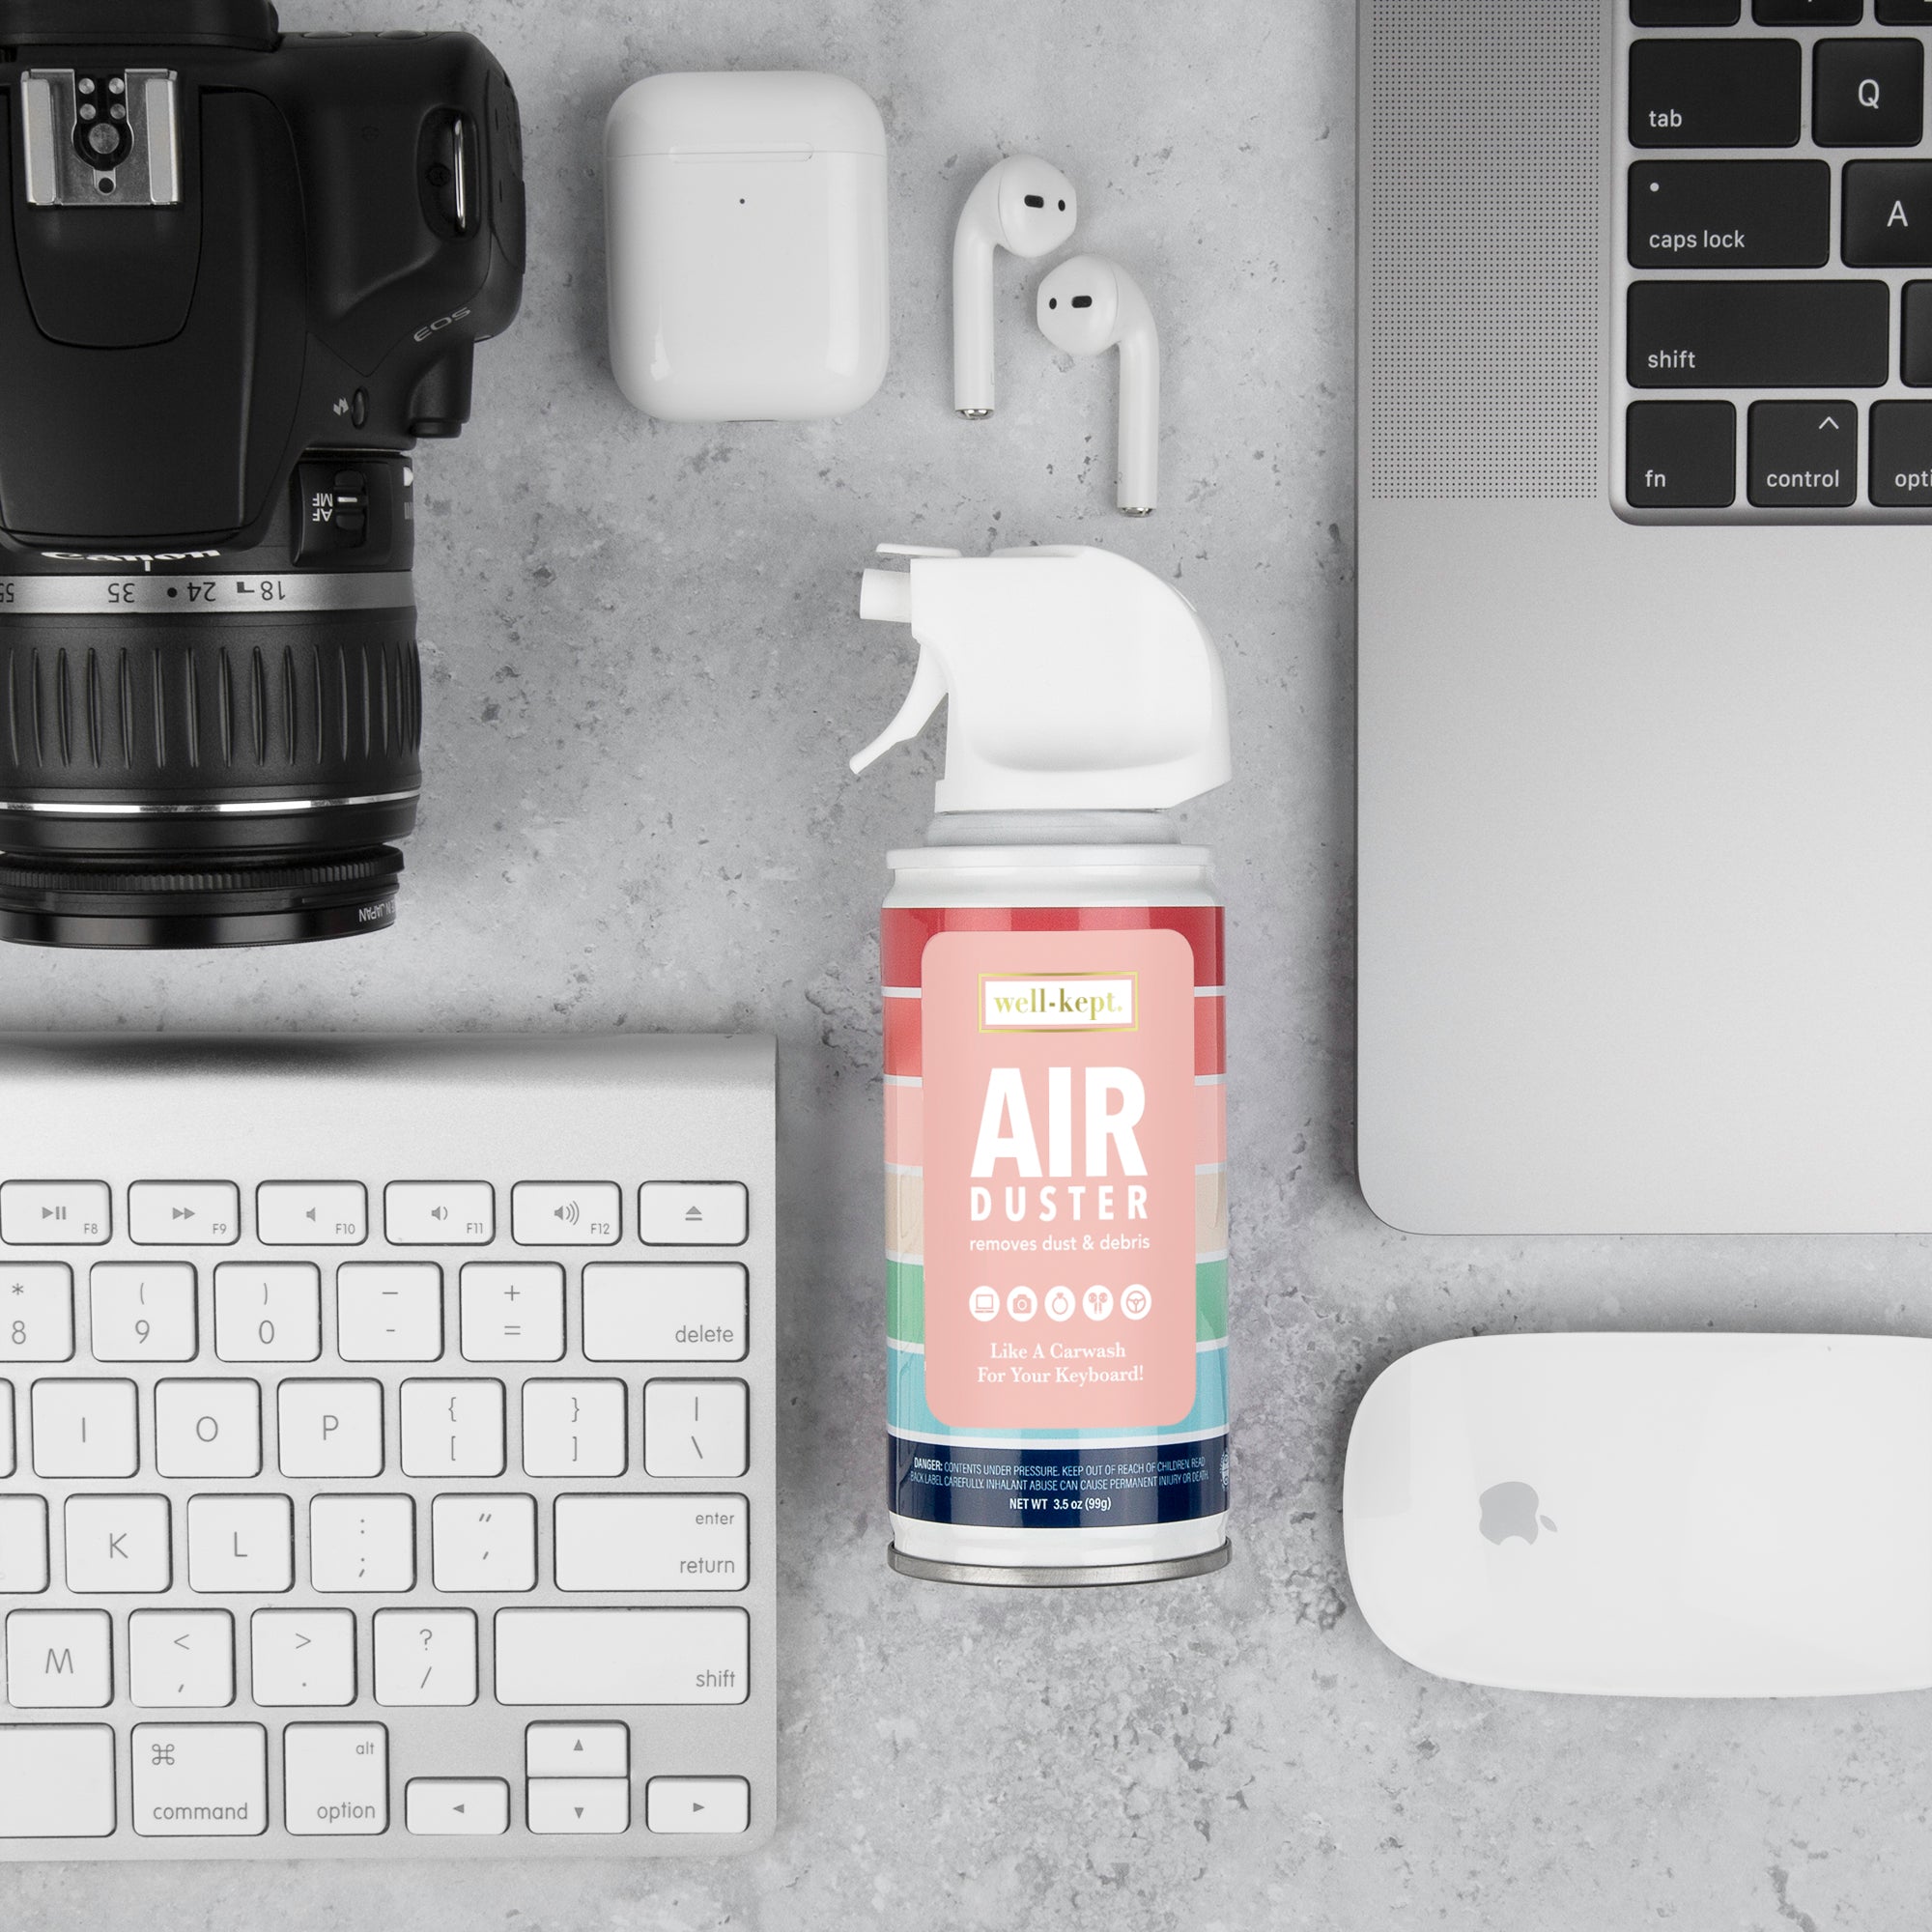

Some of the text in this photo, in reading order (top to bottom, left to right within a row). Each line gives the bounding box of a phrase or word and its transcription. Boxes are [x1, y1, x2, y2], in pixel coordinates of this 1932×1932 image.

[1859, 79, 1880, 108] Q
[1649, 109, 1682, 128] tab
[1887, 201, 1908, 227] A
[1649, 229, 1746, 252] caps lock
[414, 307, 470, 342] EOS
[1648, 351, 1695, 368] shift
[1645, 470, 1665, 487] fn
[1767, 469, 1839, 488] control
[312, 493, 333, 507] MF
[312, 508, 333, 522] AF
[41, 550, 221, 561] Canon
[107, 582, 135, 603] 35
[186, 582, 215, 602] 24
[261, 581, 287, 600] 18
[994, 987, 1122, 1021] well-kept.
[970, 1066, 1149, 1178] AIR
[970, 1185, 1149, 1222] DUSTER
[83, 1224, 99, 1235] F8
[213, 1224, 227, 1235] F9
[335, 1224, 355, 1235] F10
[467, 1223, 483, 1234] F11
[590, 1224, 611, 1235] F12
[970, 1234, 1151, 1251] removes dust & debris
[12, 1321, 26, 1344] 8
[135, 1321, 150, 1344] 9
[259, 1321, 274, 1344] 0
[675, 1324, 734, 1343] delete
[990, 1342, 1126, 1359] Like A Carwash
[977, 1365, 1144, 1387] For Your Keyboard!
[196, 1416, 218, 1442] O
[323, 1415, 339, 1440] P
[914, 1457, 943, 1471] DANGER:
[944, 1462, 981, 1475] CONTENTS
[983, 1464, 1011, 1476] UNDER
[1013, 1465, 1061, 1477] PRESSURE.
[1063, 1465, 1084, 1476] KEEP
[1086, 1465, 1103, 1476] OUT
[1104, 1464, 1117, 1475] OF
[1118, 1463, 1145, 1475] REACH
[1146, 1463, 1156, 1473] OF
[1191, 1456, 1206, 1468] READ
[924, 1474, 944, 1487] LABEL
[986, 1479, 1028, 1491] INHALANT
[1030, 1480, 1058, 1492] ABUSE
[1060, 1480, 1078, 1491] CAN
[1080, 1479, 1109, 1491] CAUSE
[1111, 1475, 1158, 1489] PERMANENT
[1159, 1473, 1181, 1486] INJURY
[1009, 1497, 1112, 1511] NET WT 3.5 oz (99g)
[696, 1512, 735, 1525] enter
[109, 1533, 128, 1558] K
[234, 1532, 248, 1557] L
[679, 1557, 735, 1574] return
[45, 1648, 74, 1674] M
[696, 1669, 736, 1688] shift
[355, 1741, 375, 1755] alt
[153, 1802, 248, 1821] command
[317, 1802, 376, 1824] option
